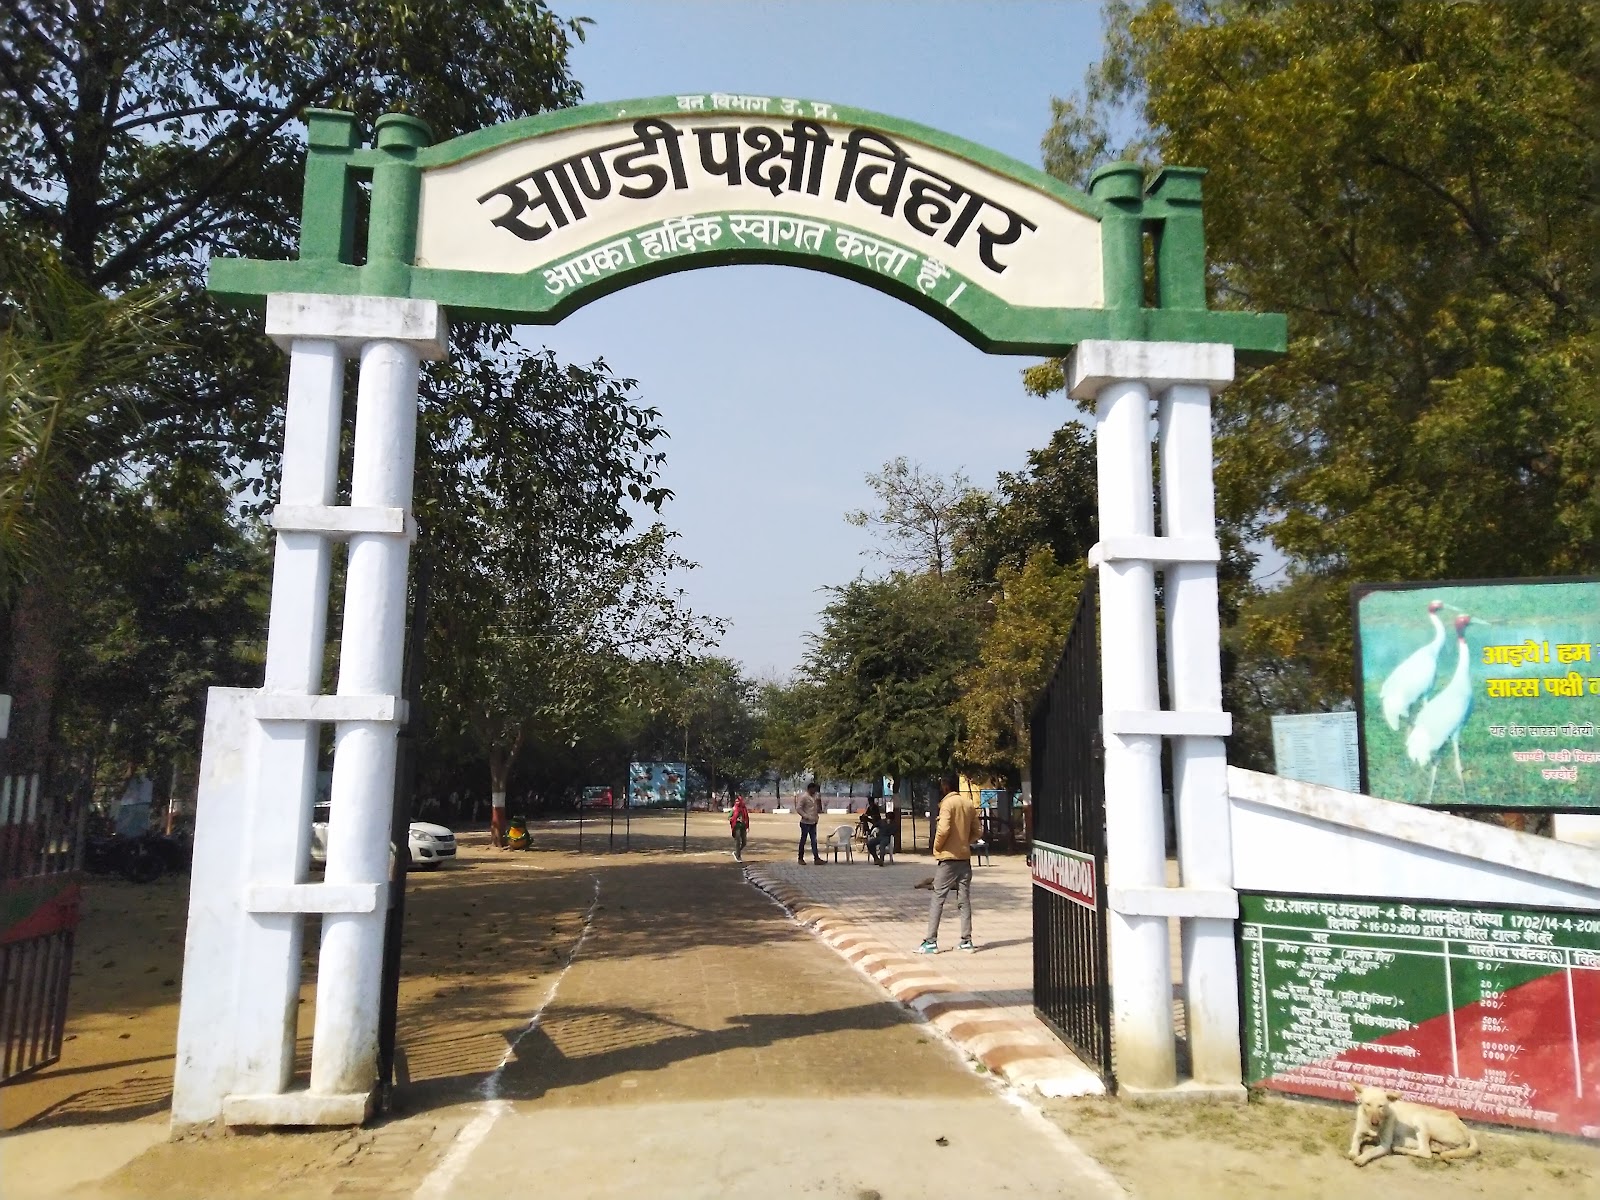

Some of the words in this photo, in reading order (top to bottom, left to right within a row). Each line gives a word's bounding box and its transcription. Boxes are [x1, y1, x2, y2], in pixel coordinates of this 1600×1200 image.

[676, 95, 705, 110] वन
[711, 92, 771, 112] विभाग
[476, 117, 689, 242] साण्डी
[691, 117, 834, 198] पक्षी
[841, 128, 1039, 275] विहार
[543, 236, 636, 295] आपका
[636, 215, 723, 259] हार्दिक
[728, 214, 831, 251] स्वागत
[835, 226, 918, 277] करता
[1556, 643, 1592, 664] हम
[1486, 678, 1540, 697] सारस
[1543, 671, 1584, 697] पक्षी
[1489, 725, 1506, 738] यह
[1528, 725, 1558, 738] सारस
[1547, 748, 1571, 762] पक्षी
